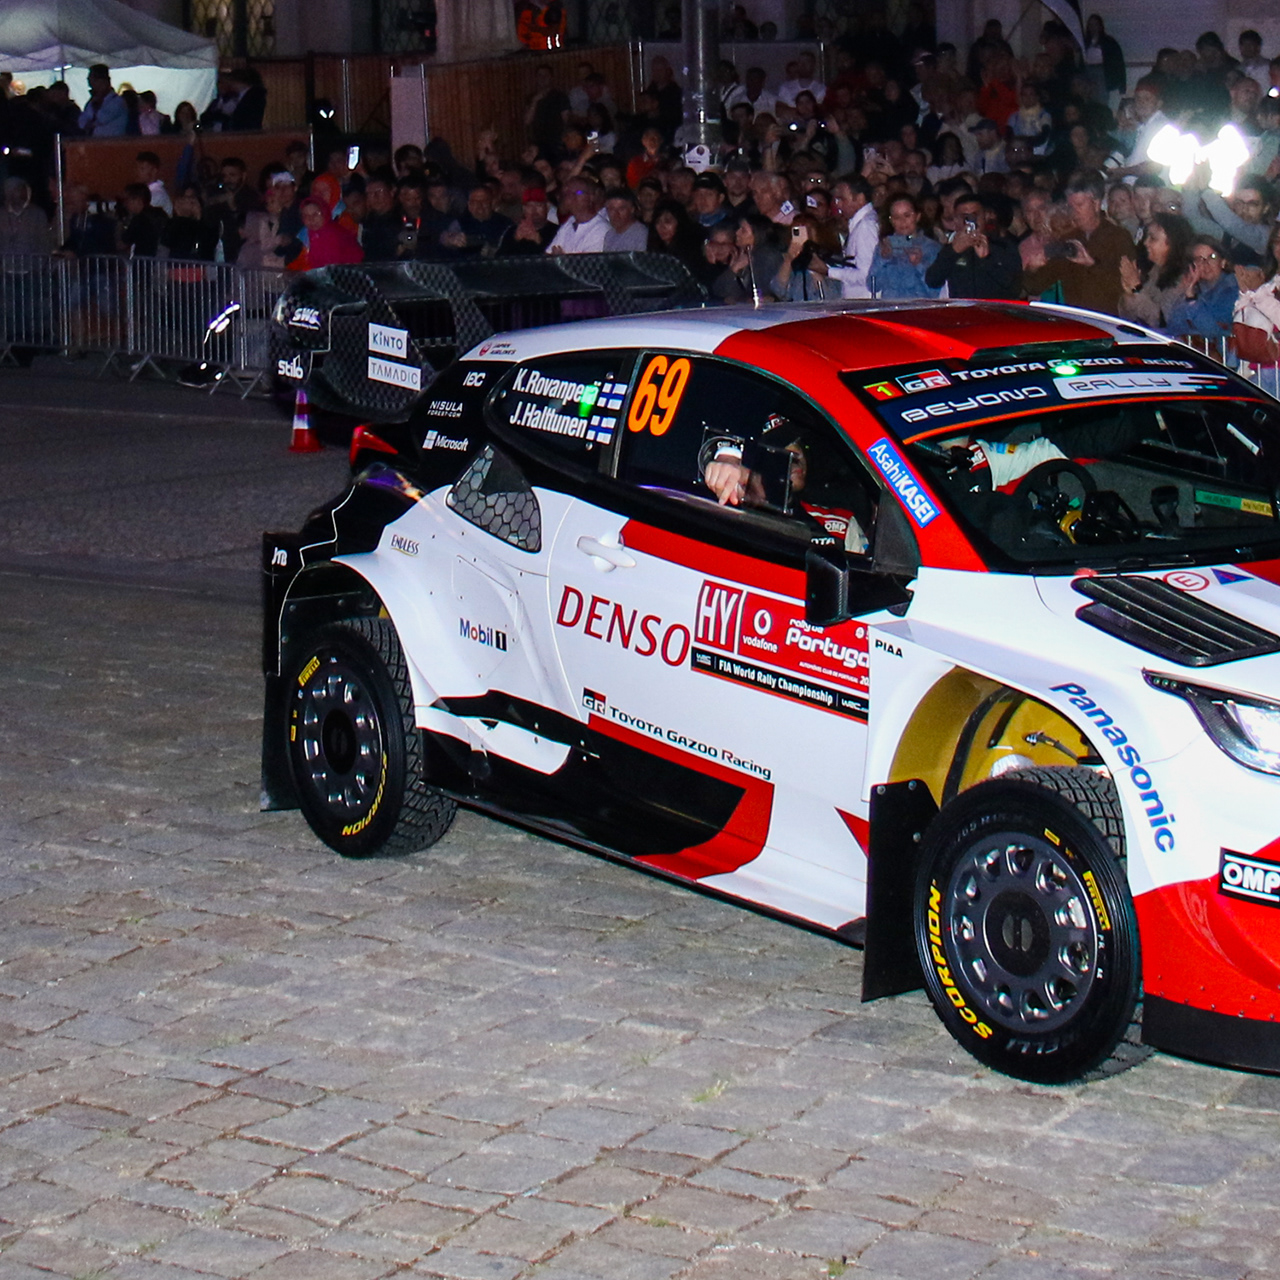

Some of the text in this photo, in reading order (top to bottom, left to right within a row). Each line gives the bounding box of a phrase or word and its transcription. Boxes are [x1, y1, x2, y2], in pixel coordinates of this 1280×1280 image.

[371, 363, 419, 385] TAMADIC
[951, 362, 1045, 381] TOYOTA
[429, 400, 464, 413] NISULA
[627, 355, 691, 437] 69
[900, 376, 1173, 423] BEYOND RALLY
[509, 401, 589, 439] J.Halttunen
[435, 434, 469, 452] Microsoft
[870, 443, 936, 524] AsahiKASEI
[390, 534, 420, 555] ENDLESS
[824, 520, 847, 533] OMP
[556, 584, 692, 668] DENSO
[696, 584, 739, 646] HY
[459, 617, 508, 652] Mobil 1
[742, 635, 778, 654] vodafone
[875, 639, 904, 658] PIAA
[298, 656, 321, 688] PIRELLI
[719, 659, 834, 707] FIA World Rally Championship
[583, 694, 772, 781] GR TOYOTA GAZOO Racing
[1048, 682, 1176, 853] Panasonic
[1083, 871, 1111, 931] PIRELLI
[927, 885, 994, 1040] SCORPION
